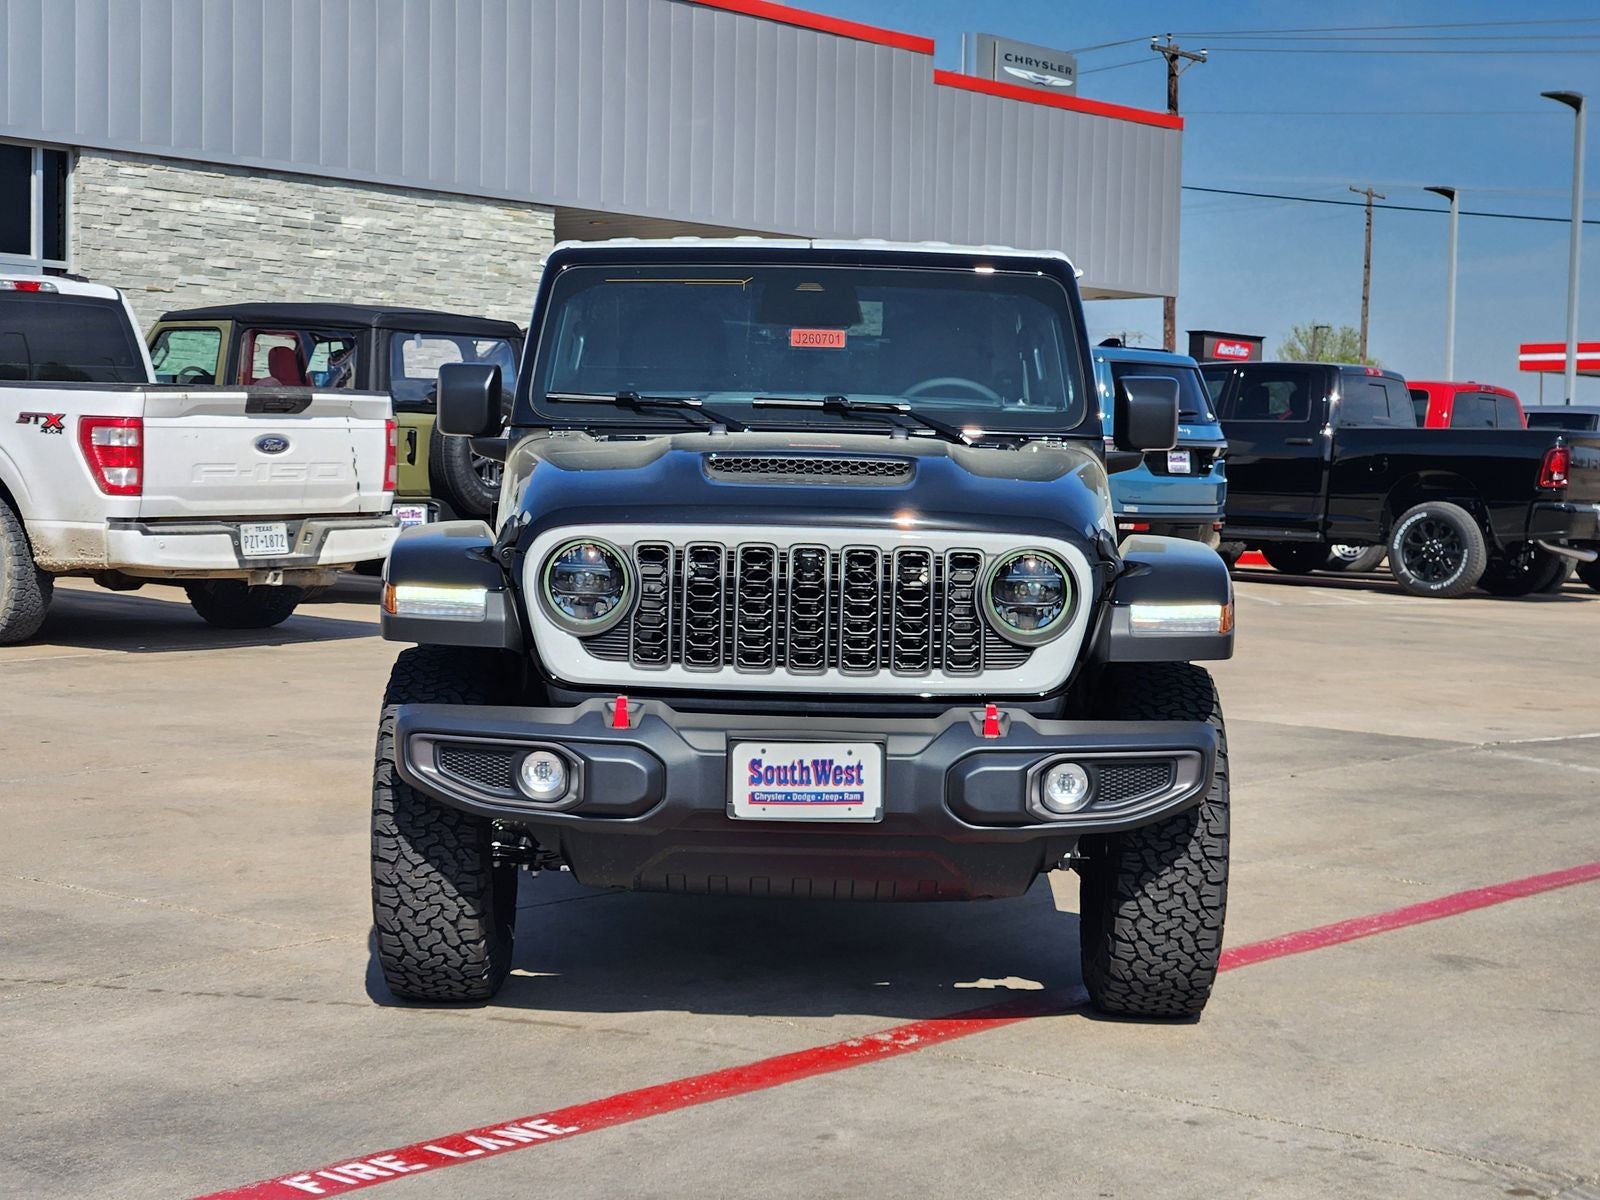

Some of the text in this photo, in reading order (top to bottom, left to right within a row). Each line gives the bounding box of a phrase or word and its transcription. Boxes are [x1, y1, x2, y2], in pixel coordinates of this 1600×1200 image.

[1004, 53, 1073, 75] CHRYSLER
[795, 333, 840, 345] J260701
[15, 411, 66, 429] STX
[263, 438, 284, 451] Ford
[191, 462, 346, 483] F-150
[748, 757, 865, 787] SouthWest
[754, 792, 861, 803] Chrysler Dodge Jeep Ram
[279, 1118, 580, 1195] FIRE LANE
